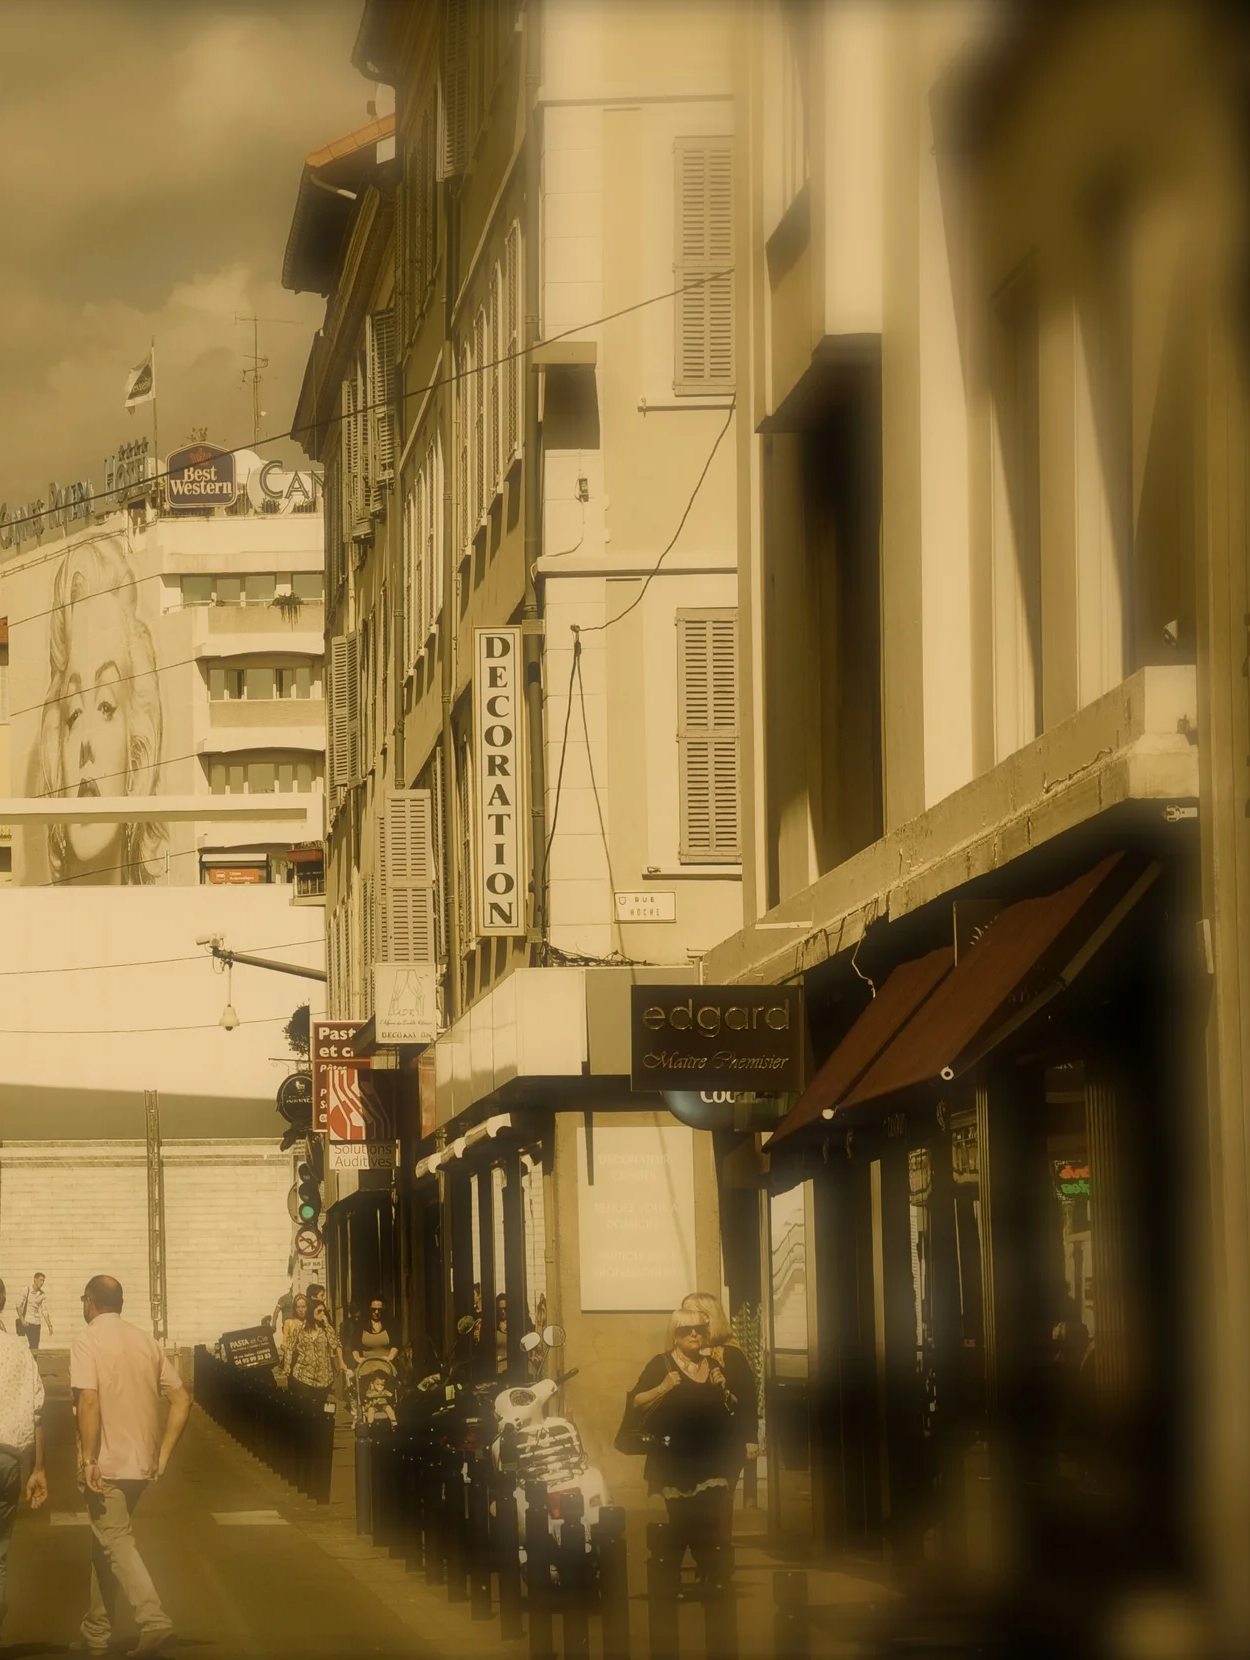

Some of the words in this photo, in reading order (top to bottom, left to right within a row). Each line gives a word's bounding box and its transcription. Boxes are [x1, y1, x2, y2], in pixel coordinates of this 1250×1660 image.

[183, 465, 218, 482] Best
[169, 479, 233, 496] Western
[484, 636, 515, 925] DECORATION
[630, 908, 660, 916] HOCHE
[642, 998, 790, 1038] edgard
[319, 1045, 338, 1058] et
[712, 1050, 790, 1071] Chemisier
[334, 1143, 392, 1155] Solutions
[335, 1155, 392, 1168] Auditives
[230, 1338, 250, 1348] PASTA
